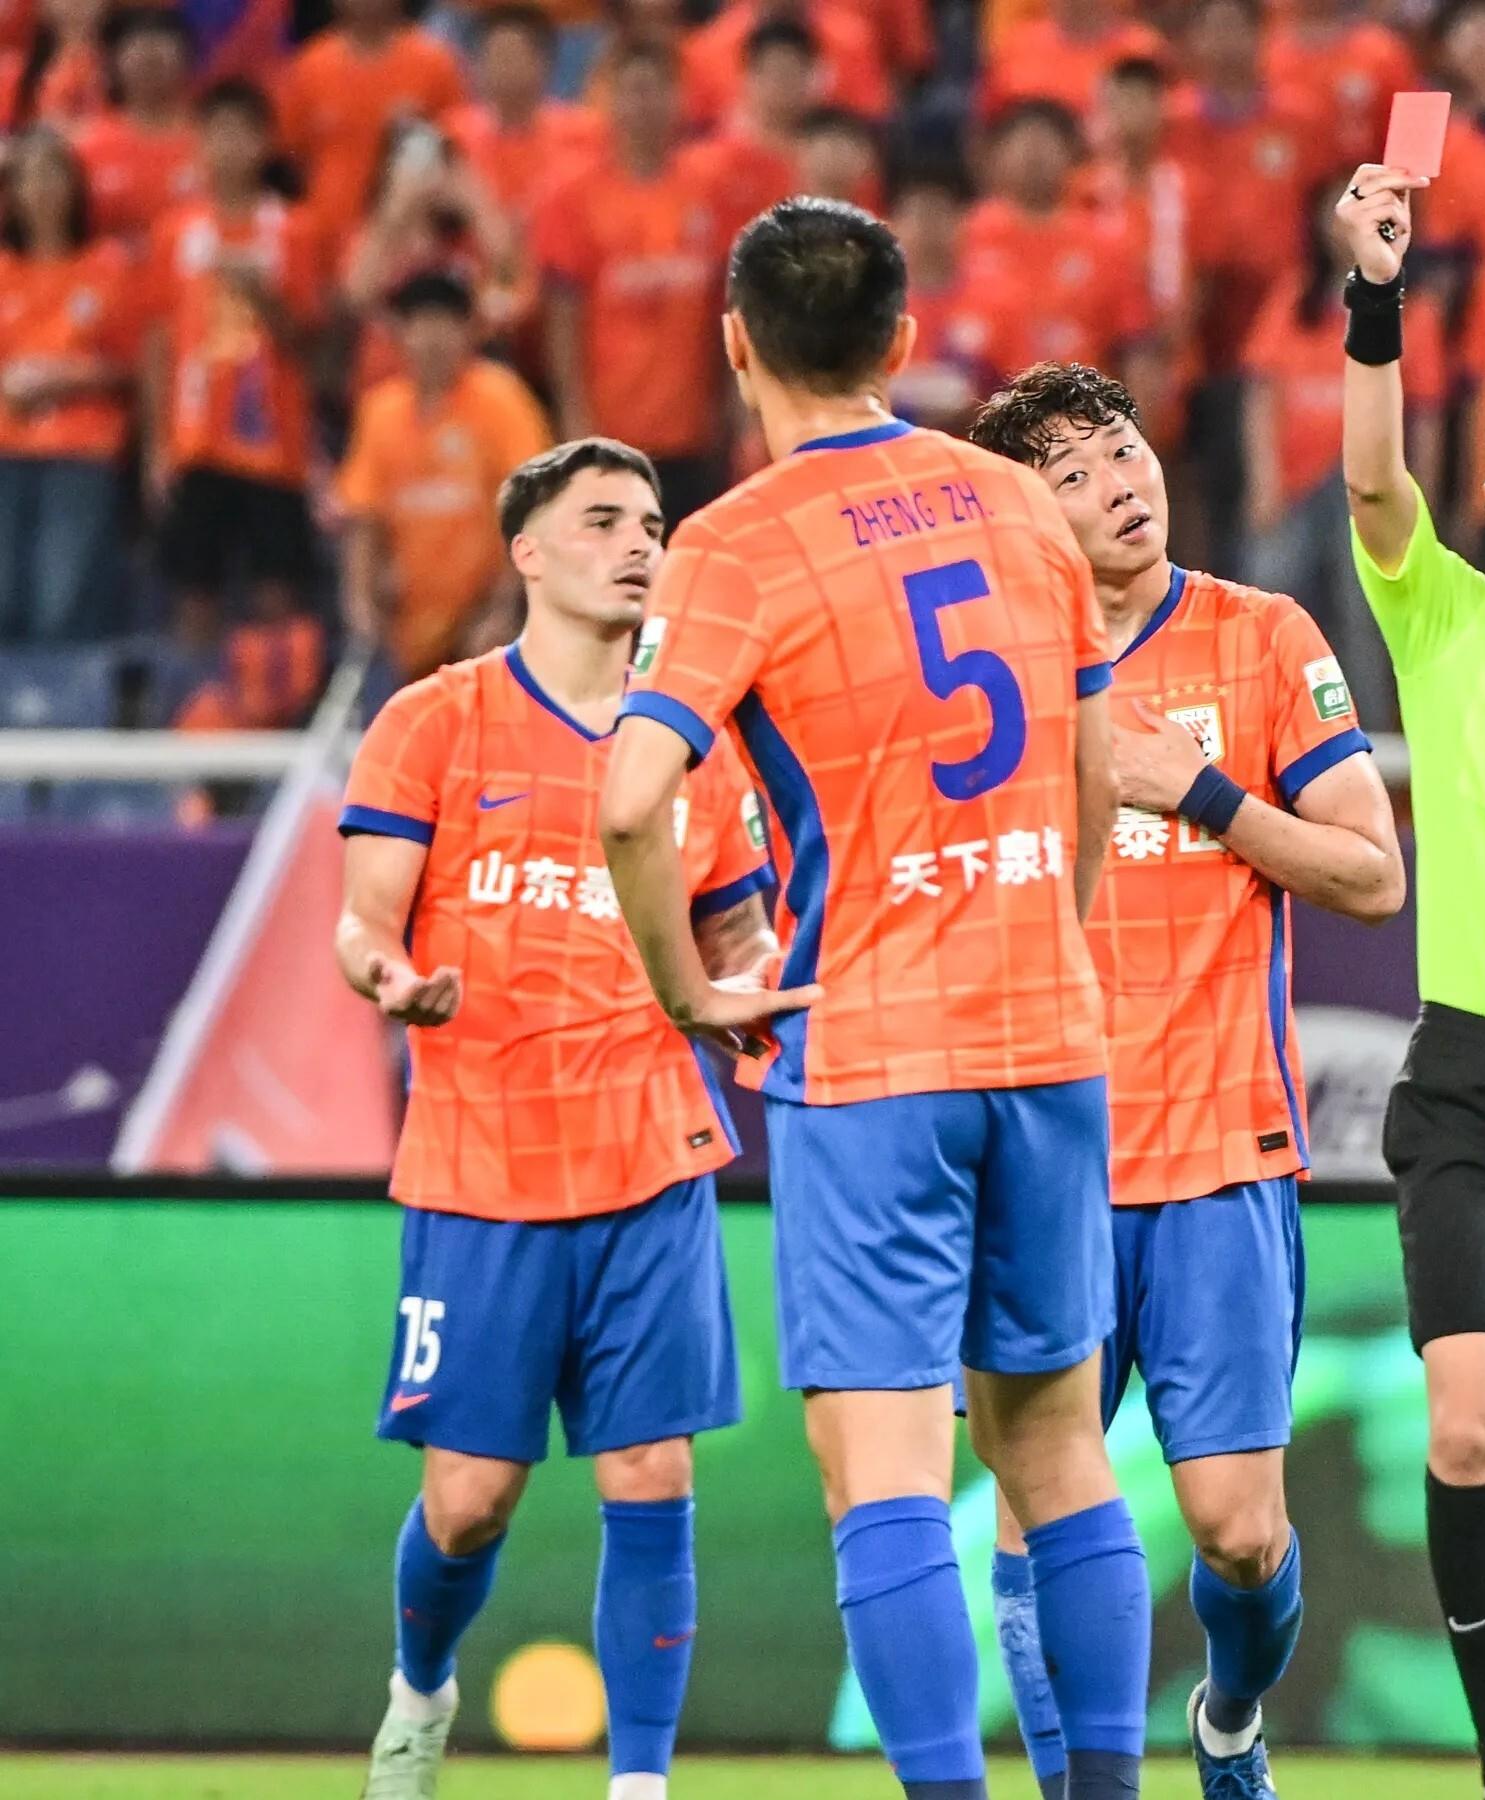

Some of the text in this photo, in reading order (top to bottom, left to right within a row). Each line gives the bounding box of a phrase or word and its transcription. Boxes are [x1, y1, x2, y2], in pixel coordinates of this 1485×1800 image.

[841, 481, 994, 547] ZHENG ZH.
[902, 558, 1028, 801] 5
[399, 1295, 446, 1384] 15
